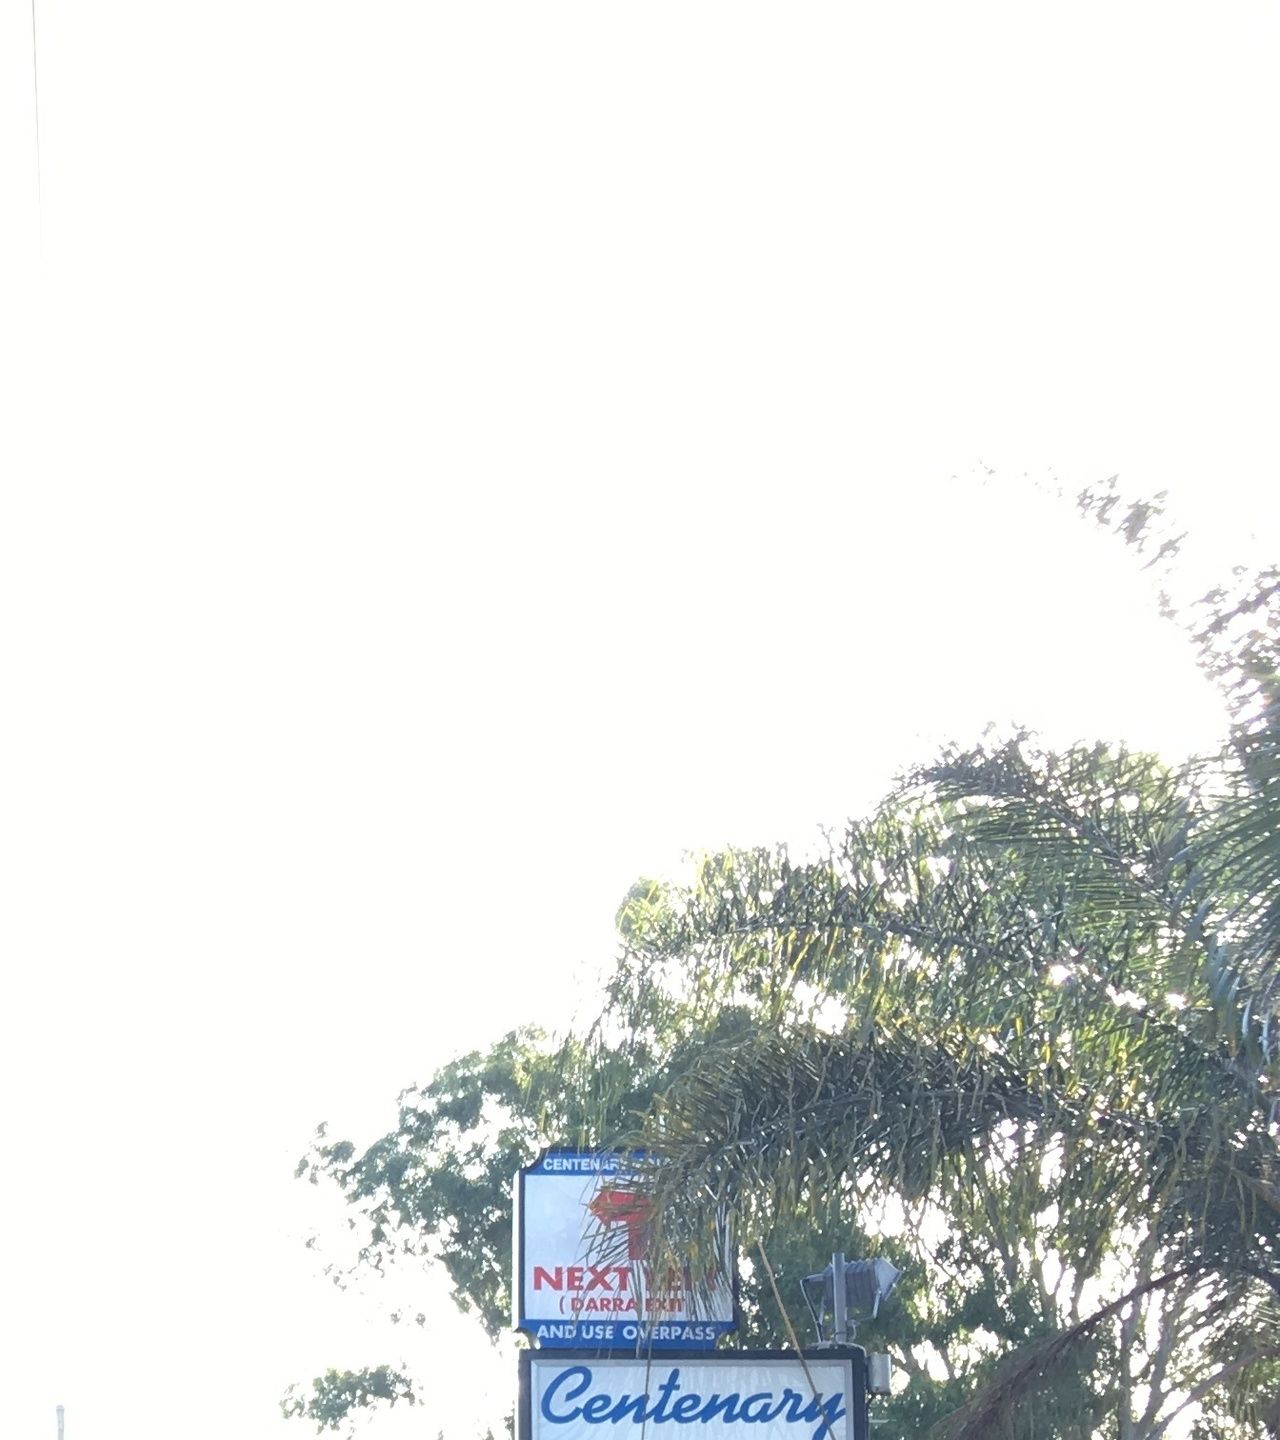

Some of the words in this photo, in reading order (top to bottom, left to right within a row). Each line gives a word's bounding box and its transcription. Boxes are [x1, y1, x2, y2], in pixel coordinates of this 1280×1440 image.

[533, 1266, 631, 1291] NEXT
[537, 1325, 577, 1339] AND
[582, 1325, 614, 1340] USE
[622, 1325, 716, 1341] OVERPASS
